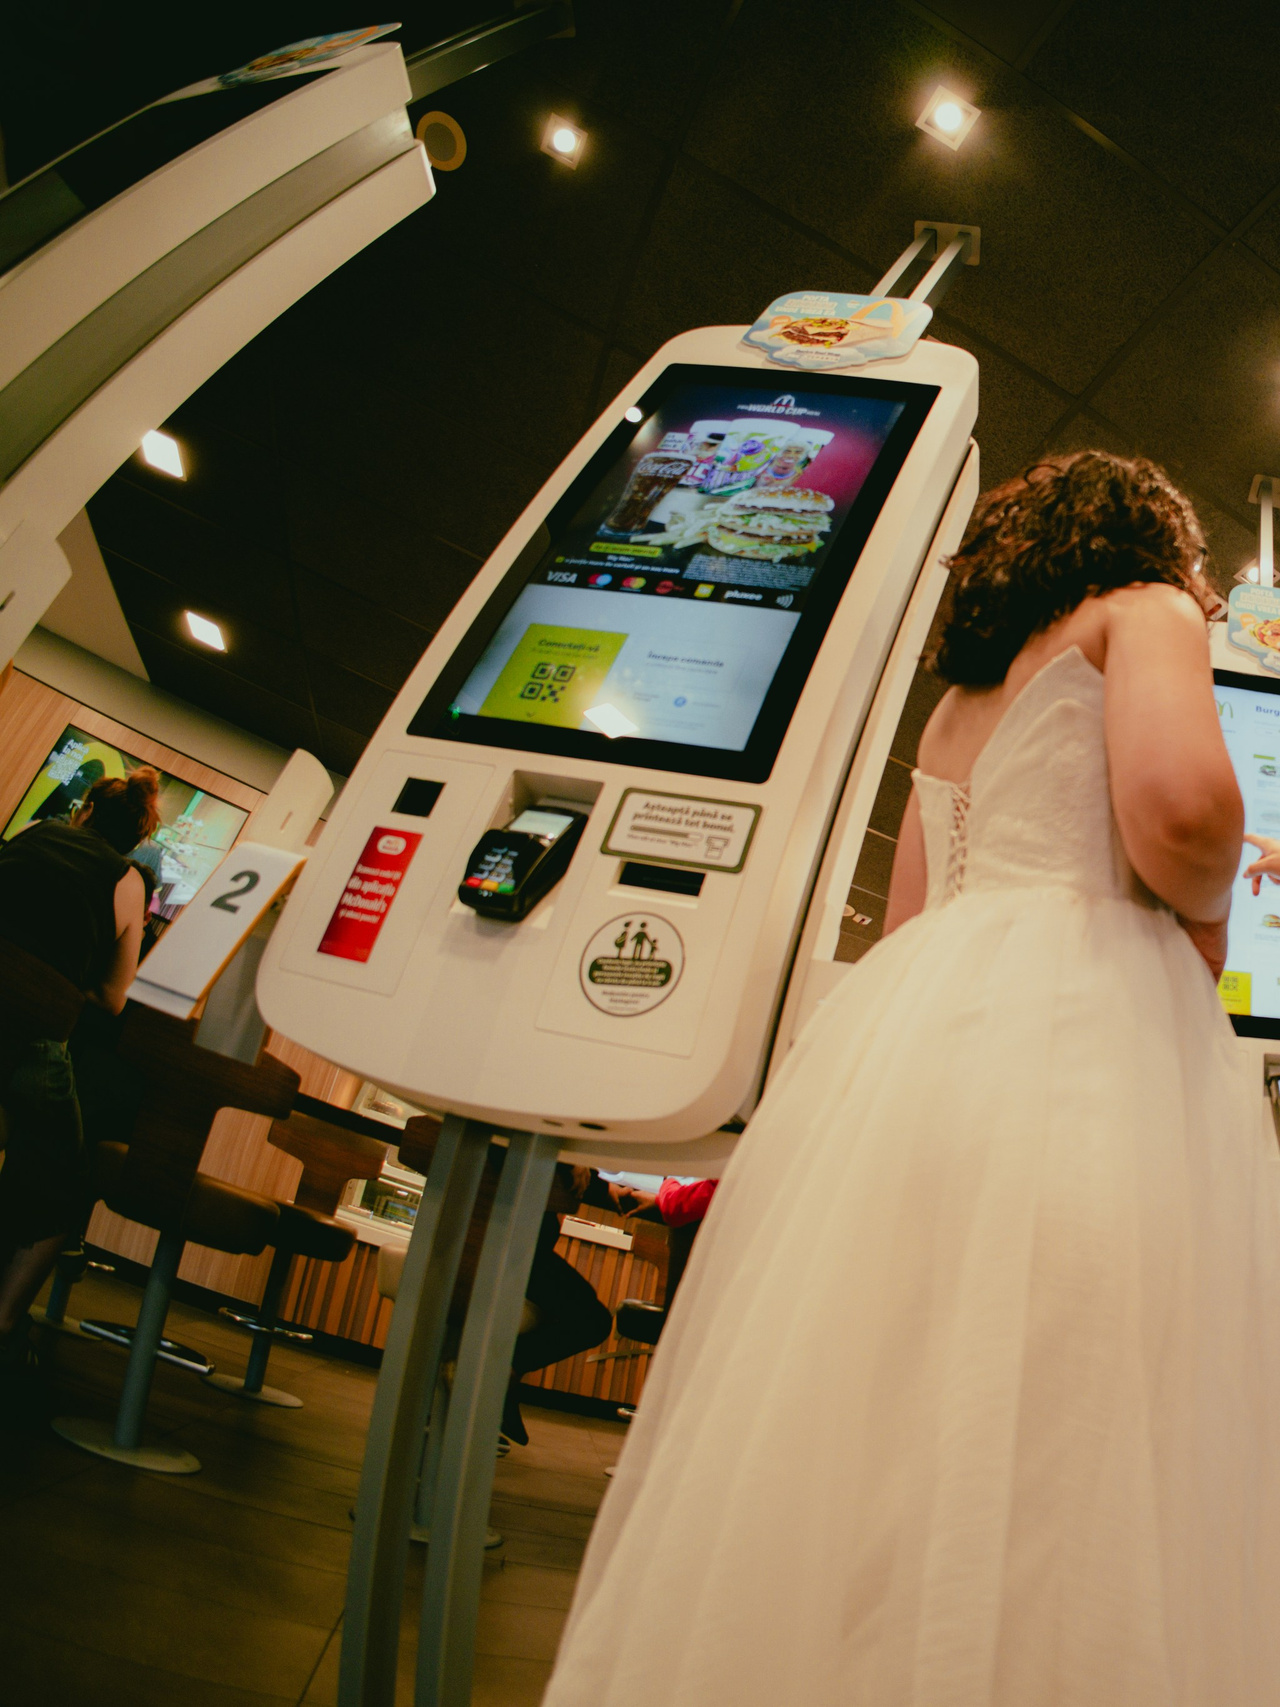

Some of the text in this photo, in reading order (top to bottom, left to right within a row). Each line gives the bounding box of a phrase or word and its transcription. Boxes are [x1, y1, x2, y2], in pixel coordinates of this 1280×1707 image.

[748, 404, 785, 414] WORLD
[784, 407, 808, 416] CUP
[546, 571, 578, 584] VISA
[724, 590, 763, 602] pluxee
[643, 801, 691, 815] Așteaptă
[632, 811, 684, 826] printează
[684, 818, 701, 828] tot
[210, 870, 261, 915] 2
